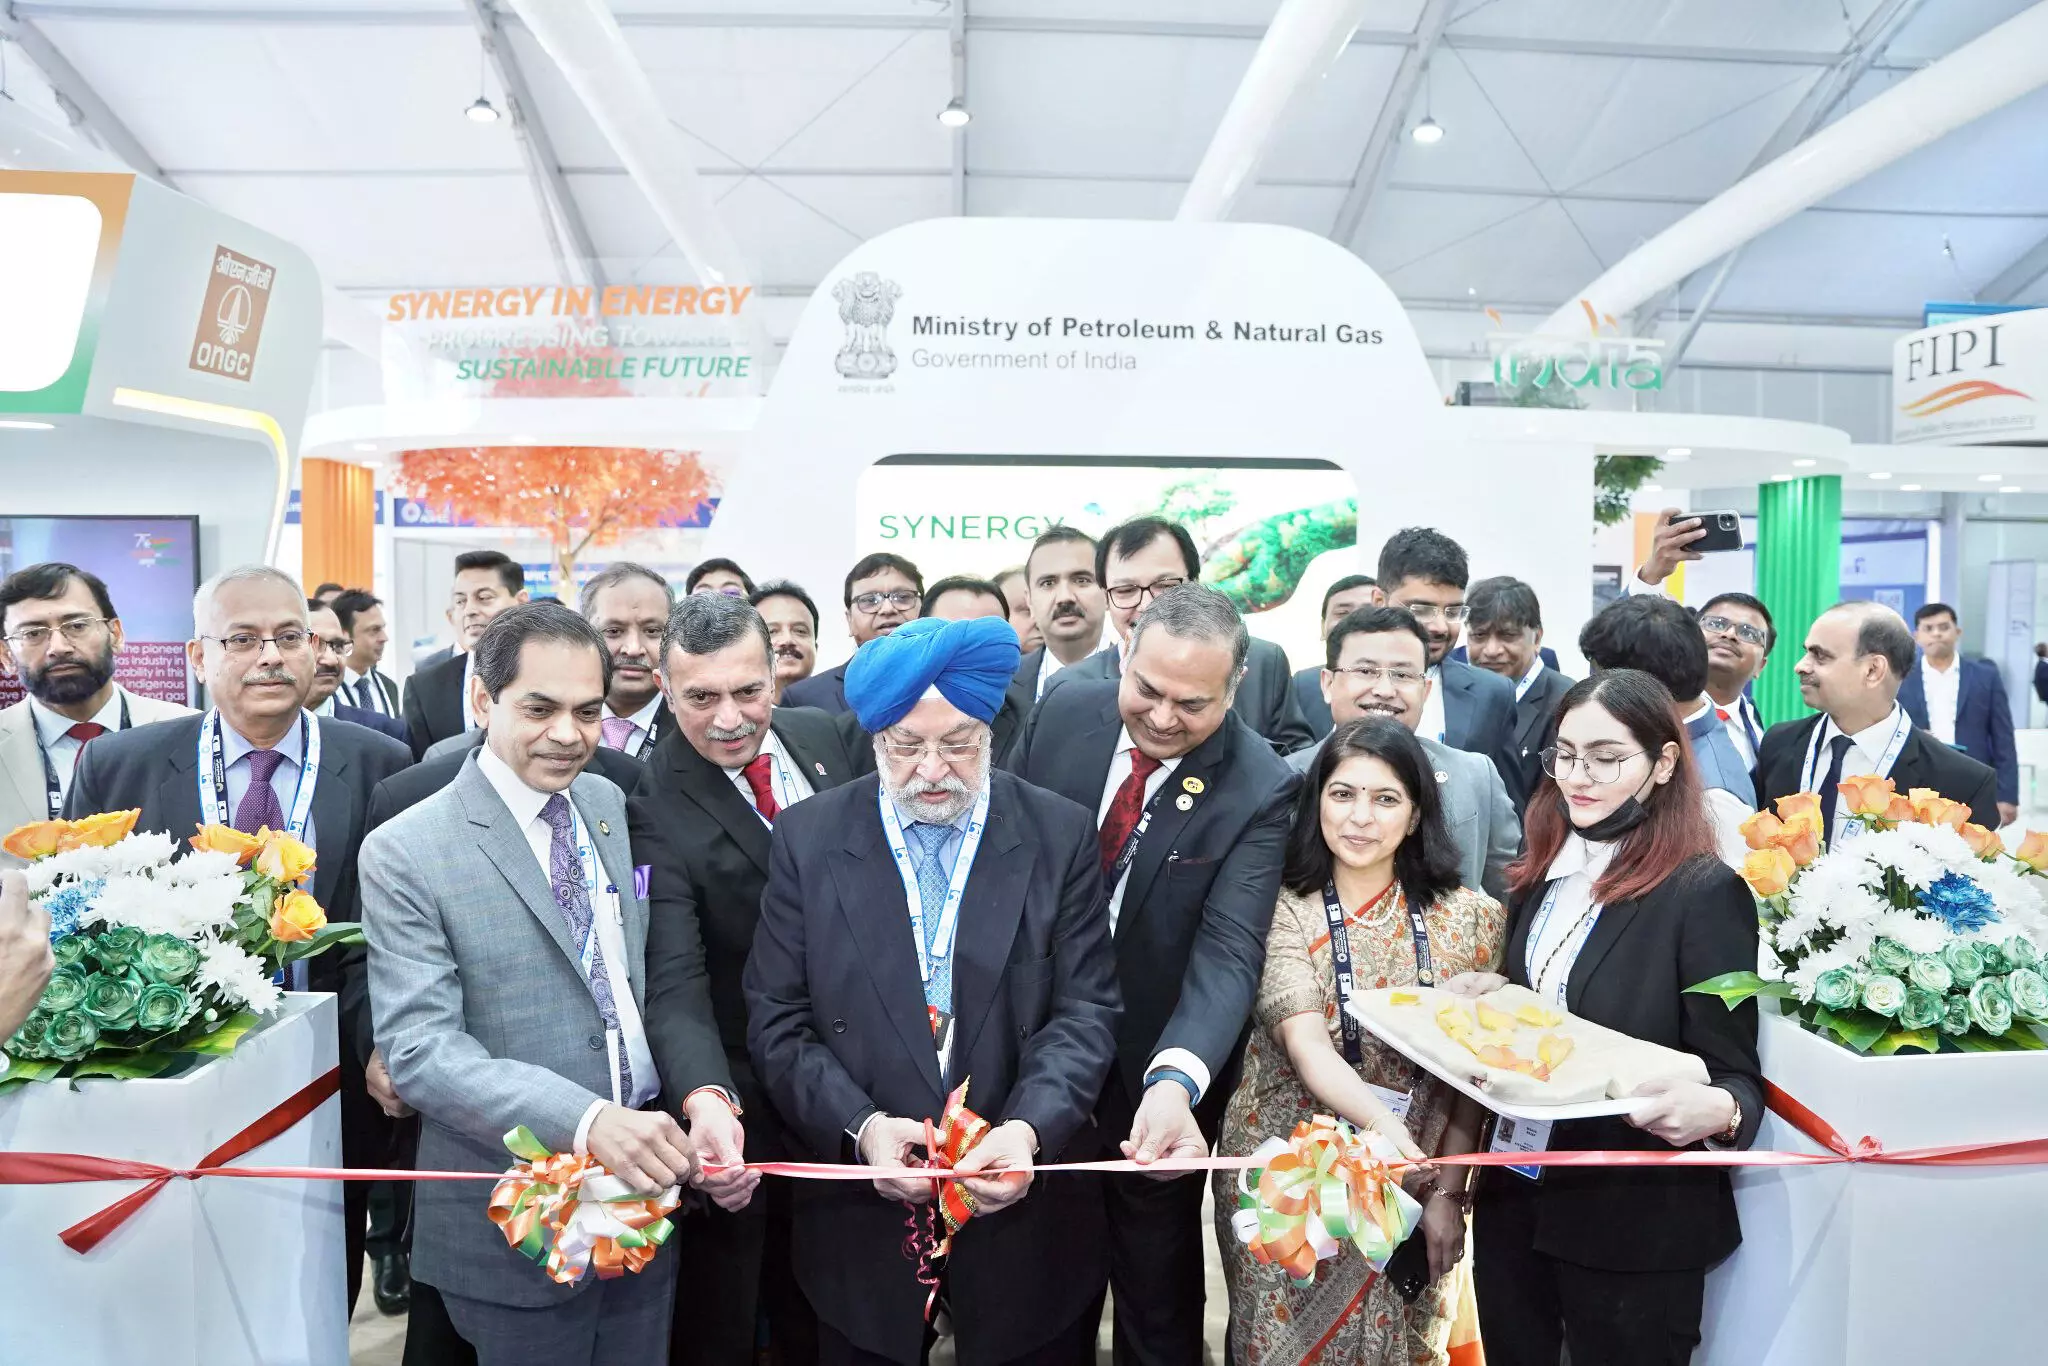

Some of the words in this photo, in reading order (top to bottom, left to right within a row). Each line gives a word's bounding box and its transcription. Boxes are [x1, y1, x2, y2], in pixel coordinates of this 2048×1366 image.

[387, 287, 547, 322] SYNERGY
[551, 286, 593, 317] IN
[601, 285, 752, 317] ENERGY
[912, 315, 1018, 341] Ministry
[1027, 317, 1052, 337] of
[1062, 317, 1195, 340] Petroleum
[1205, 320, 1223, 340] &
[1233, 321, 1326, 344] Natural
[1335, 324, 1384, 345] Gas
[912, 348, 1048, 369] Government
[1056, 350, 1077, 369] of
[1084, 350, 1137, 370] India
[1906, 323, 2006, 383] FIPI
[456, 357, 637, 380] SUSTAINABLE
[642, 356, 752, 378] FUTURE
[142, 644, 184, 655] pioneer
[173, 655, 184, 665] in
[155, 667, 165, 677] in
[167, 667, 185, 677] this
[126, 680, 185, 691] indigenous
[165, 692, 186, 703] gas
